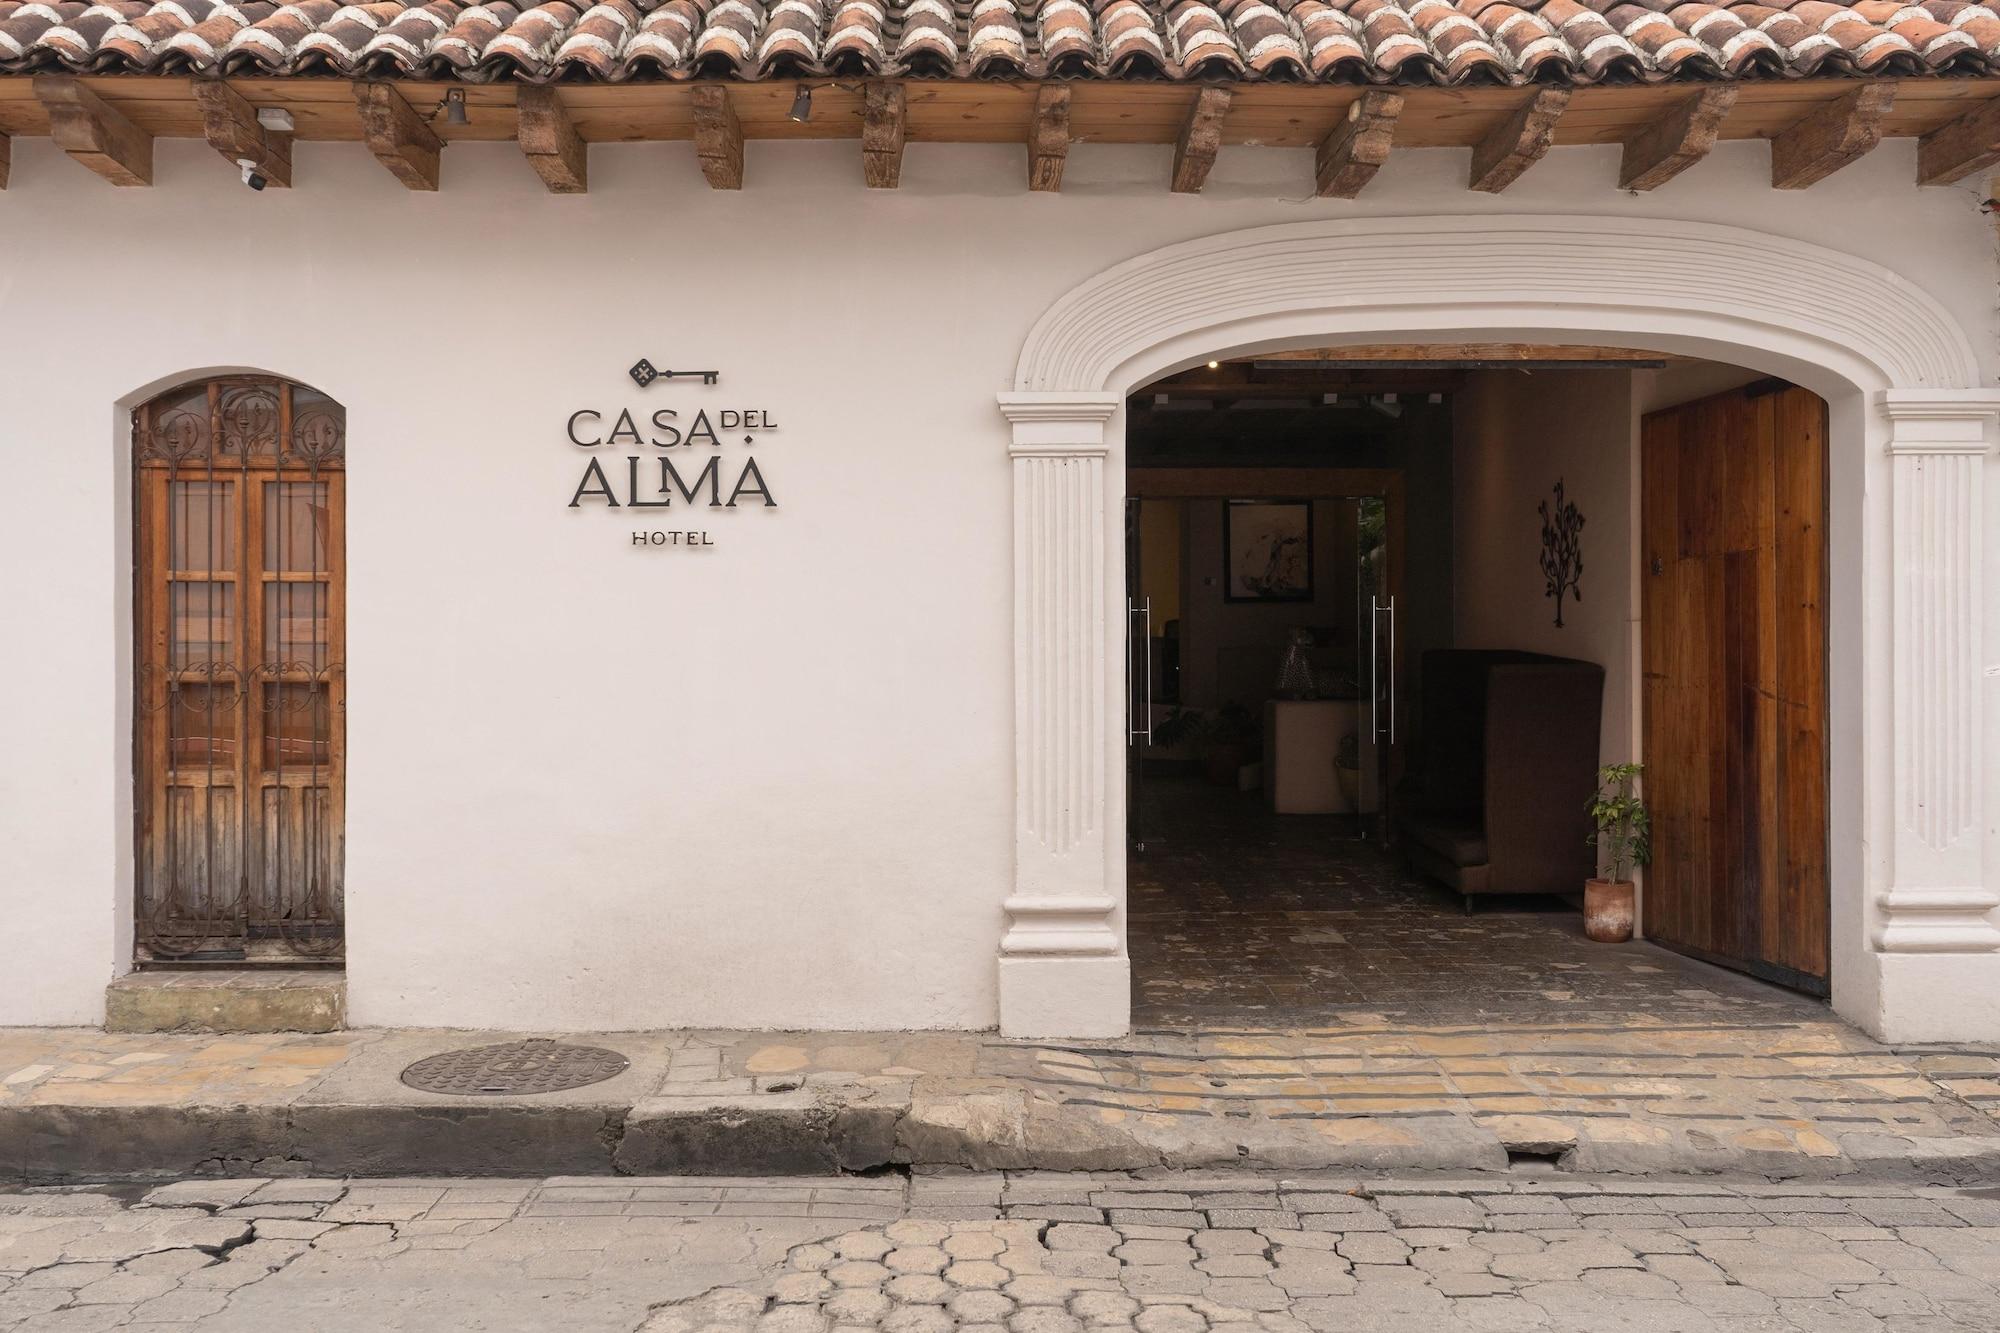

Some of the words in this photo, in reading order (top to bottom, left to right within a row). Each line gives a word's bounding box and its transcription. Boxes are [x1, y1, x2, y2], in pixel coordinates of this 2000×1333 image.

[567, 407, 721, 448] CASA
[720, 410, 778, 429] DEL
[568, 455, 778, 508] ALMA
[632, 531, 715, 546] HOTEL
